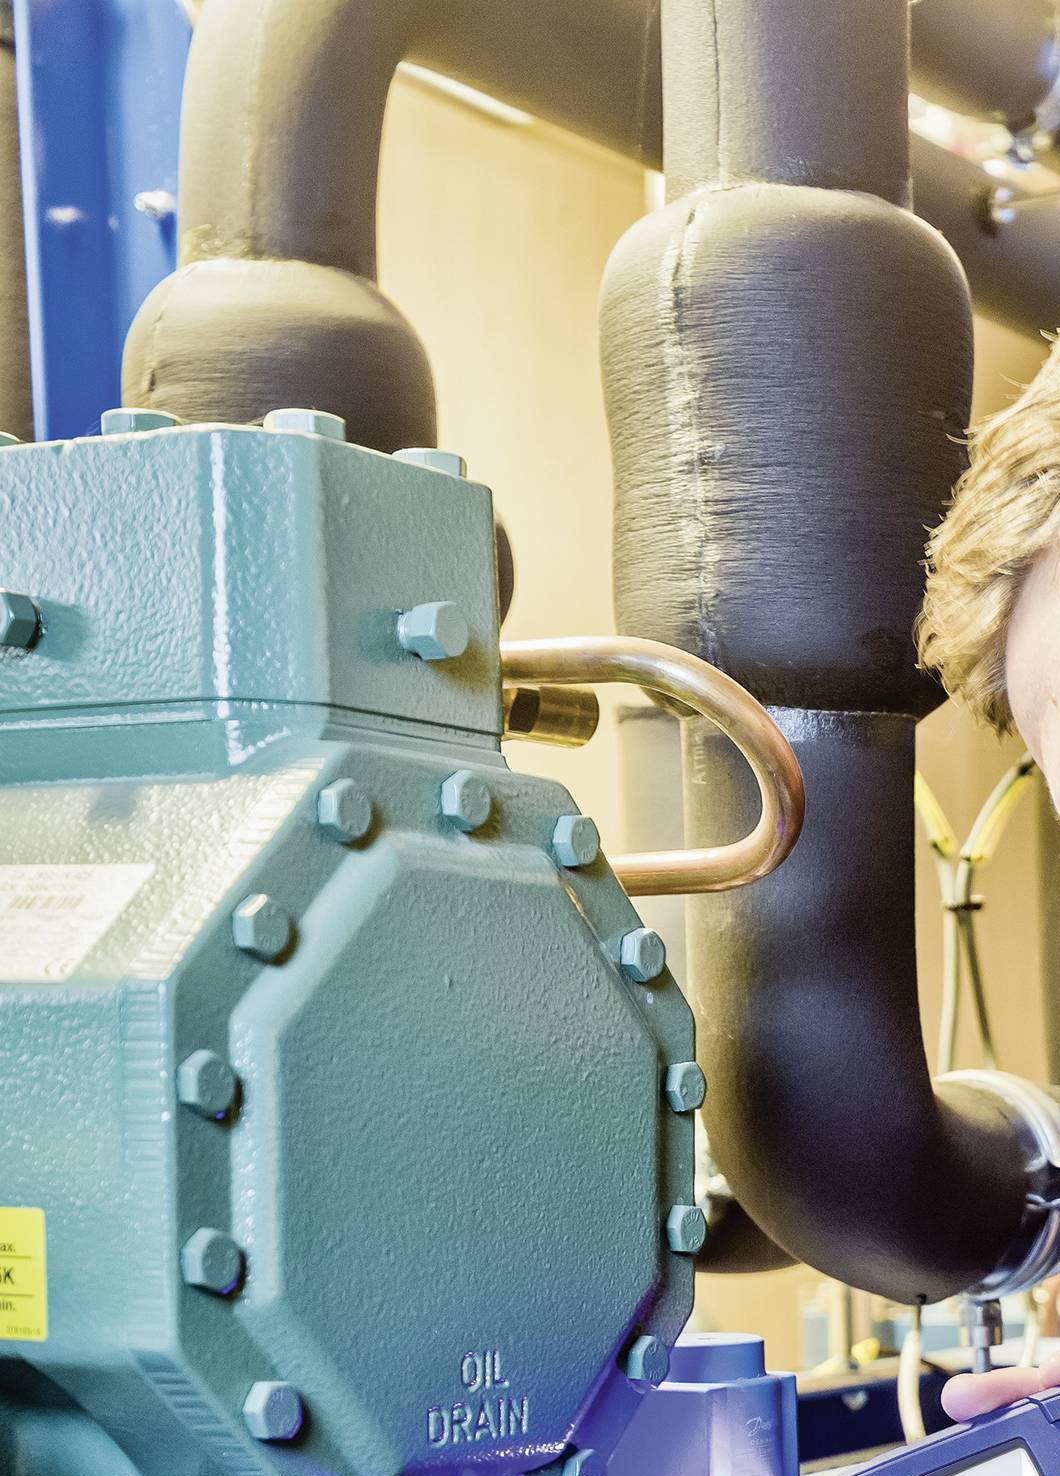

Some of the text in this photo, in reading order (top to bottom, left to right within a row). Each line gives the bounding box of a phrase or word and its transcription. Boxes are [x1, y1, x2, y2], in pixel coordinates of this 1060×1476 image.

[0, 1266, 15, 1286] K
[461, 1350, 510, 1393] OIL
[427, 1396, 529, 1449] DRAIN
